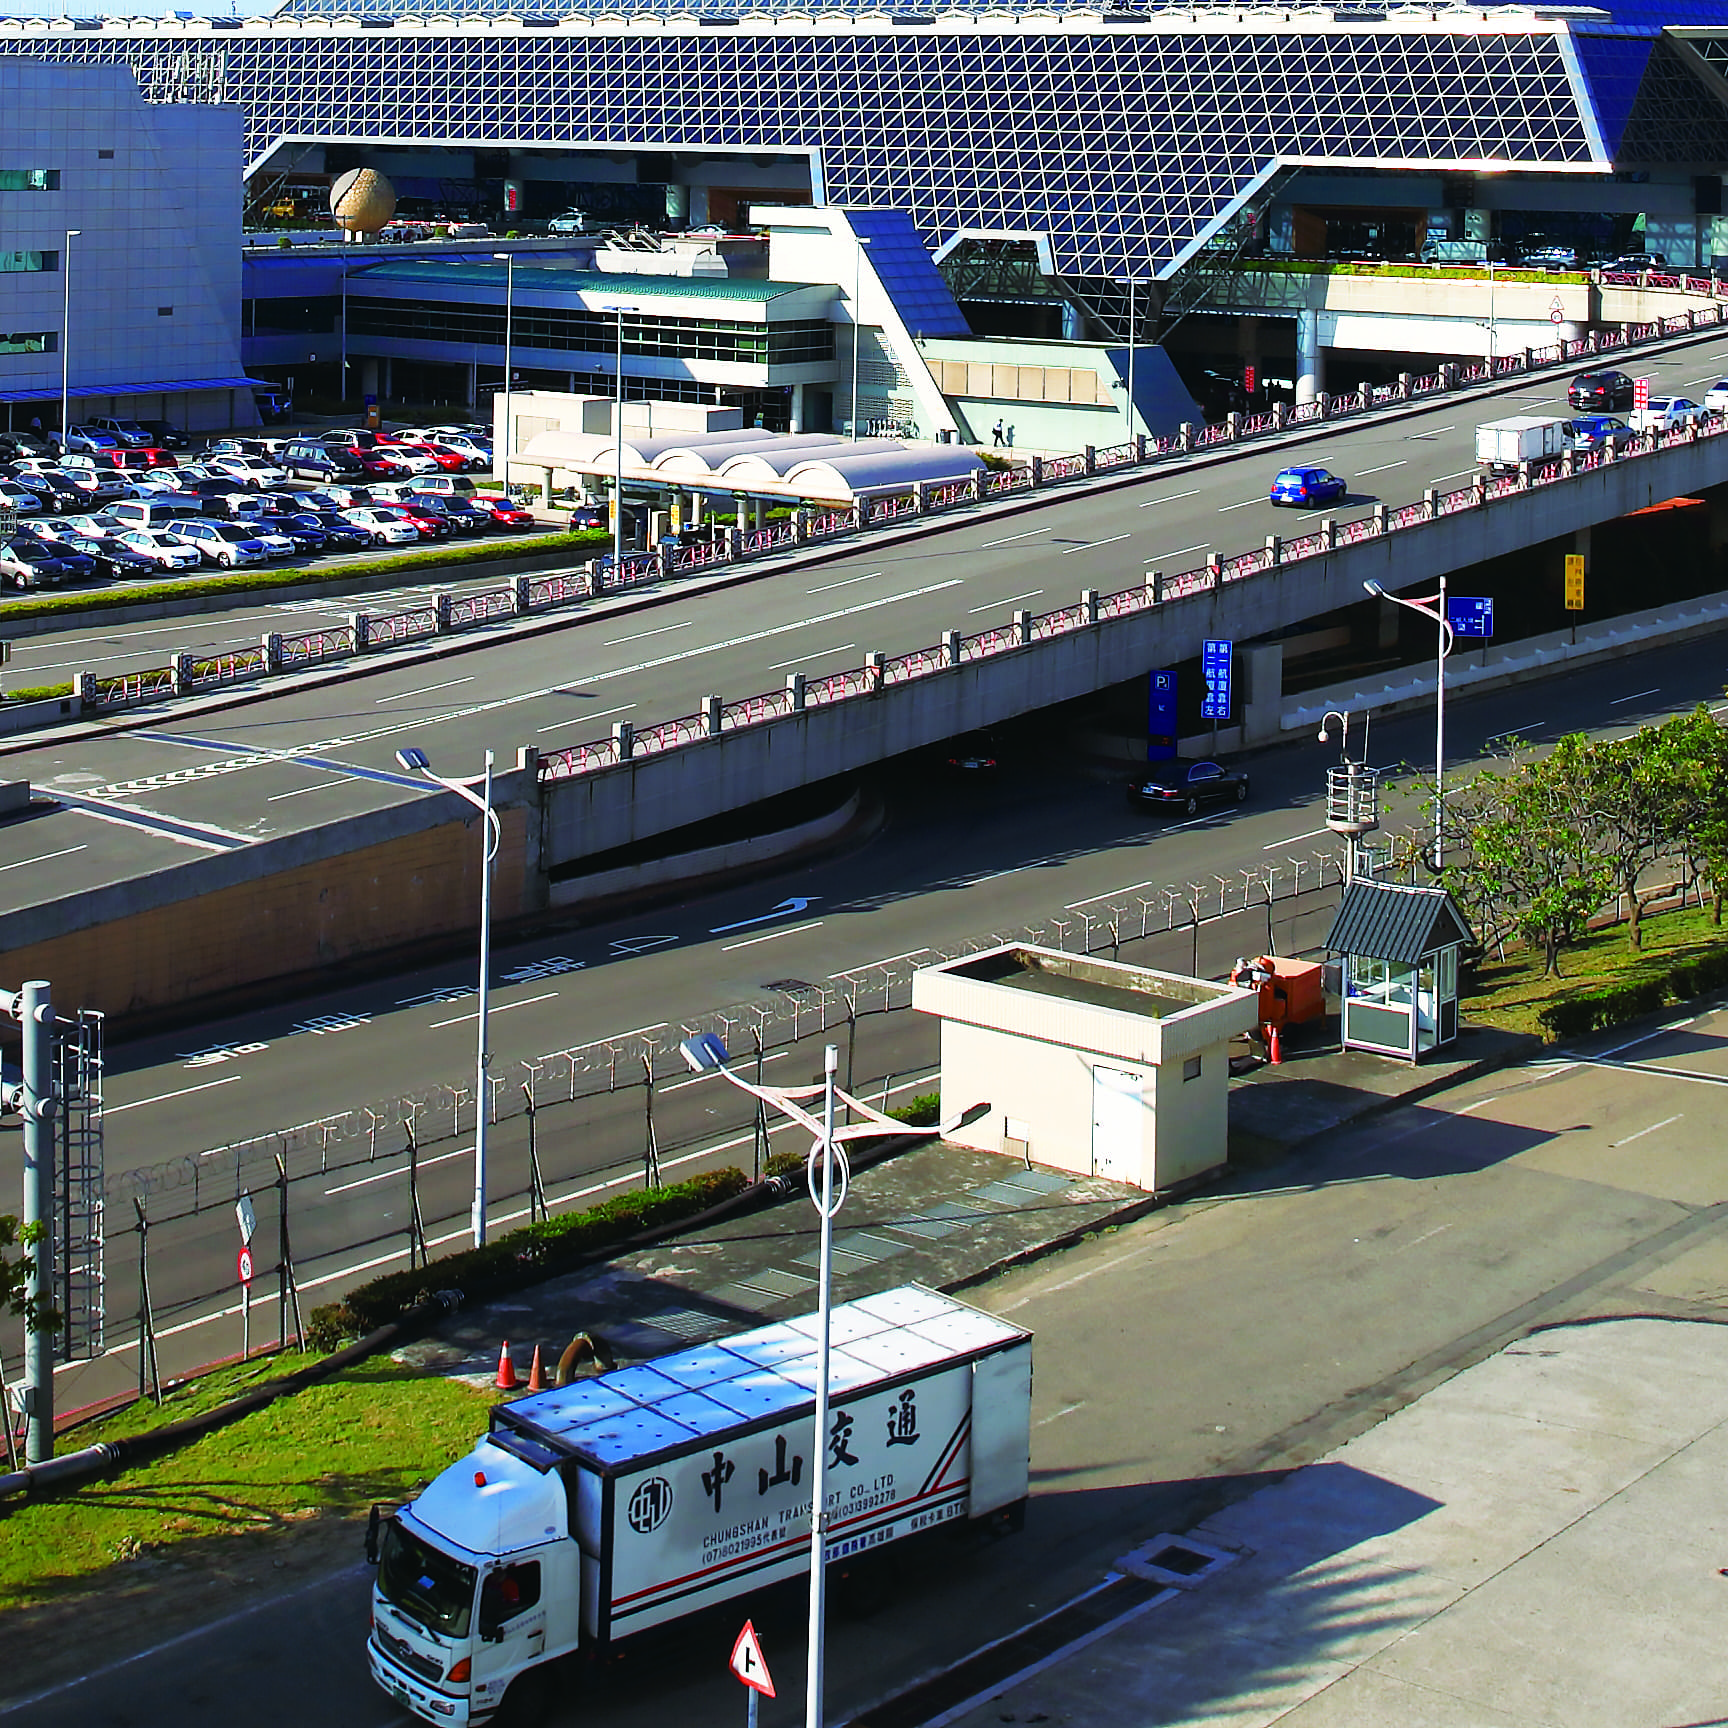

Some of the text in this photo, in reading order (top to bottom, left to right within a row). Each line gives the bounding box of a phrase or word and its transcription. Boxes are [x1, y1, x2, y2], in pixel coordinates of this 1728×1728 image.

[701, 1389, 921, 1513] 中山交通
[702, 1515, 770, 1549] CHUNGSHAN
[778, 1491, 841, 1522] TRANSRT
